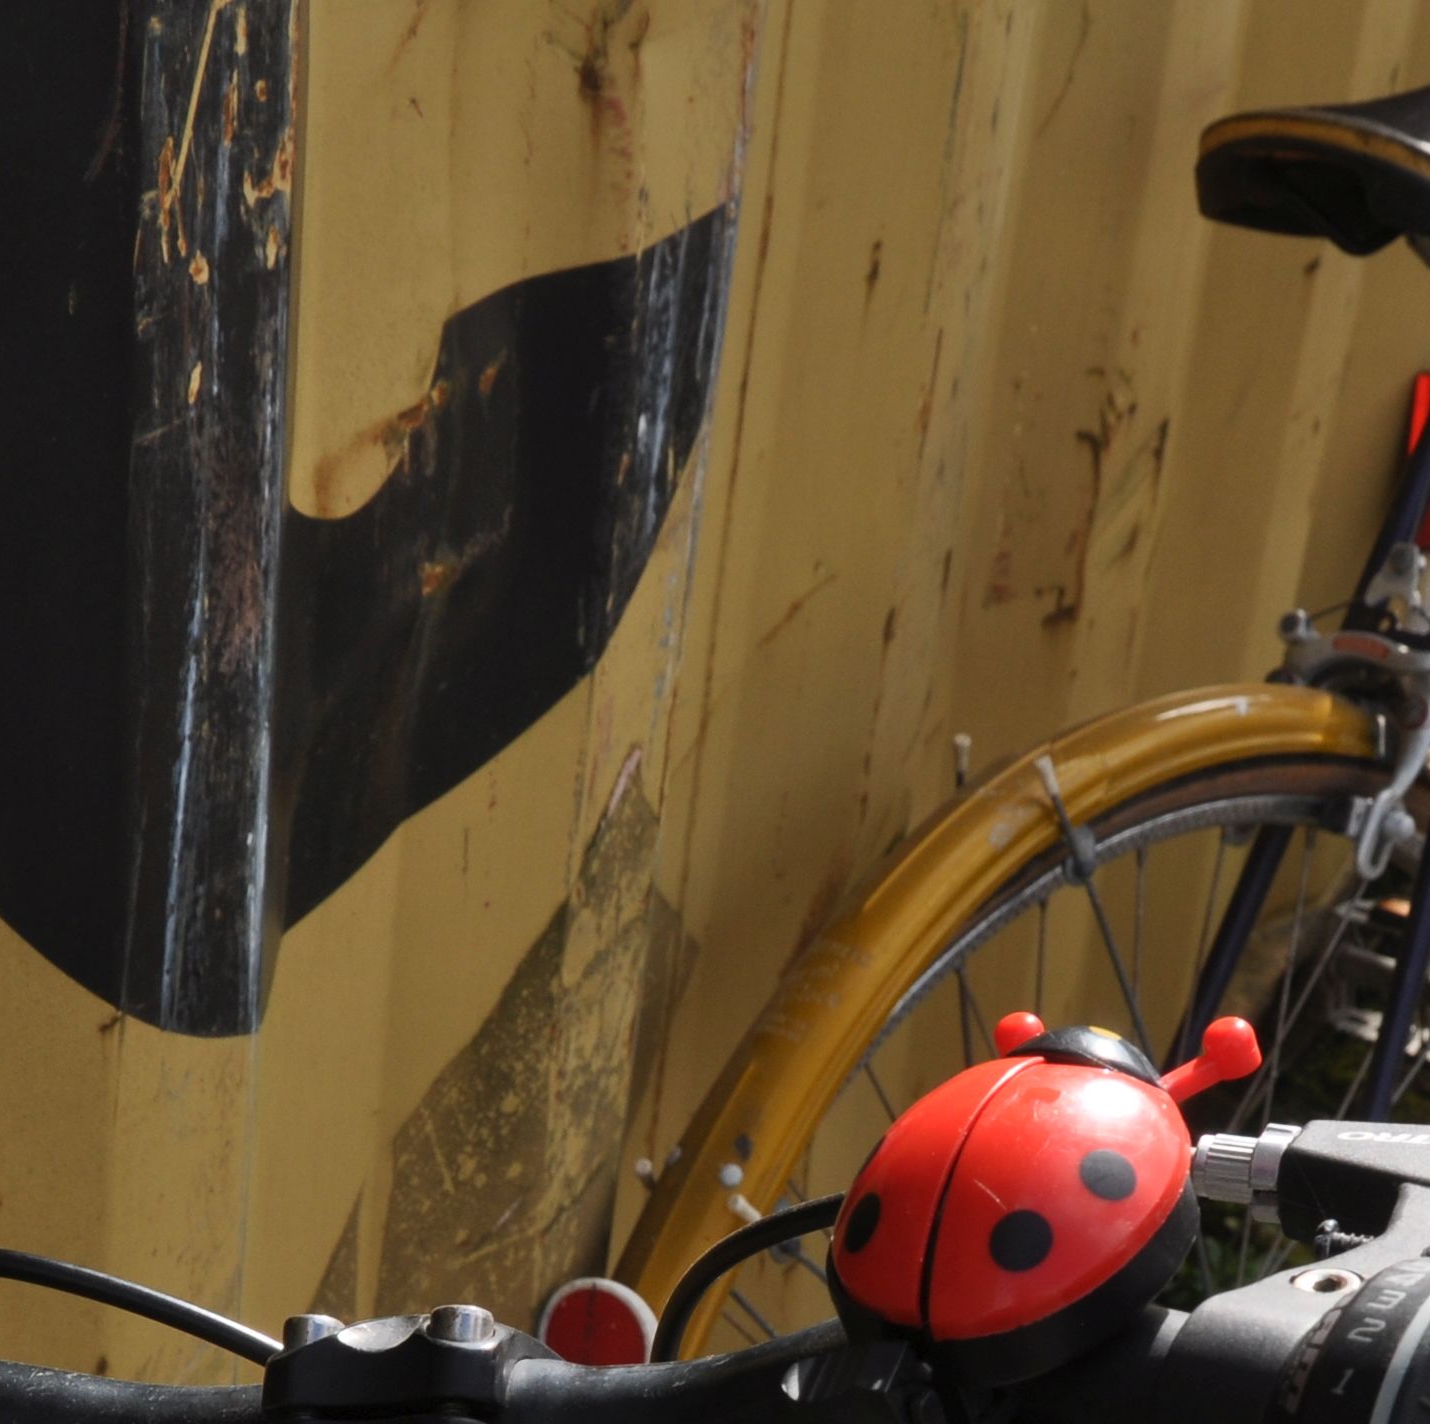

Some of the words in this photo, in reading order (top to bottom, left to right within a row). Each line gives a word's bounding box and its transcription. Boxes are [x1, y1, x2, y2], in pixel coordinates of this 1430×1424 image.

[1366, 1289, 1408, 1311] 3
[1347, 1316, 1388, 1344] 2
[1329, 1367, 1355, 1397] 1
